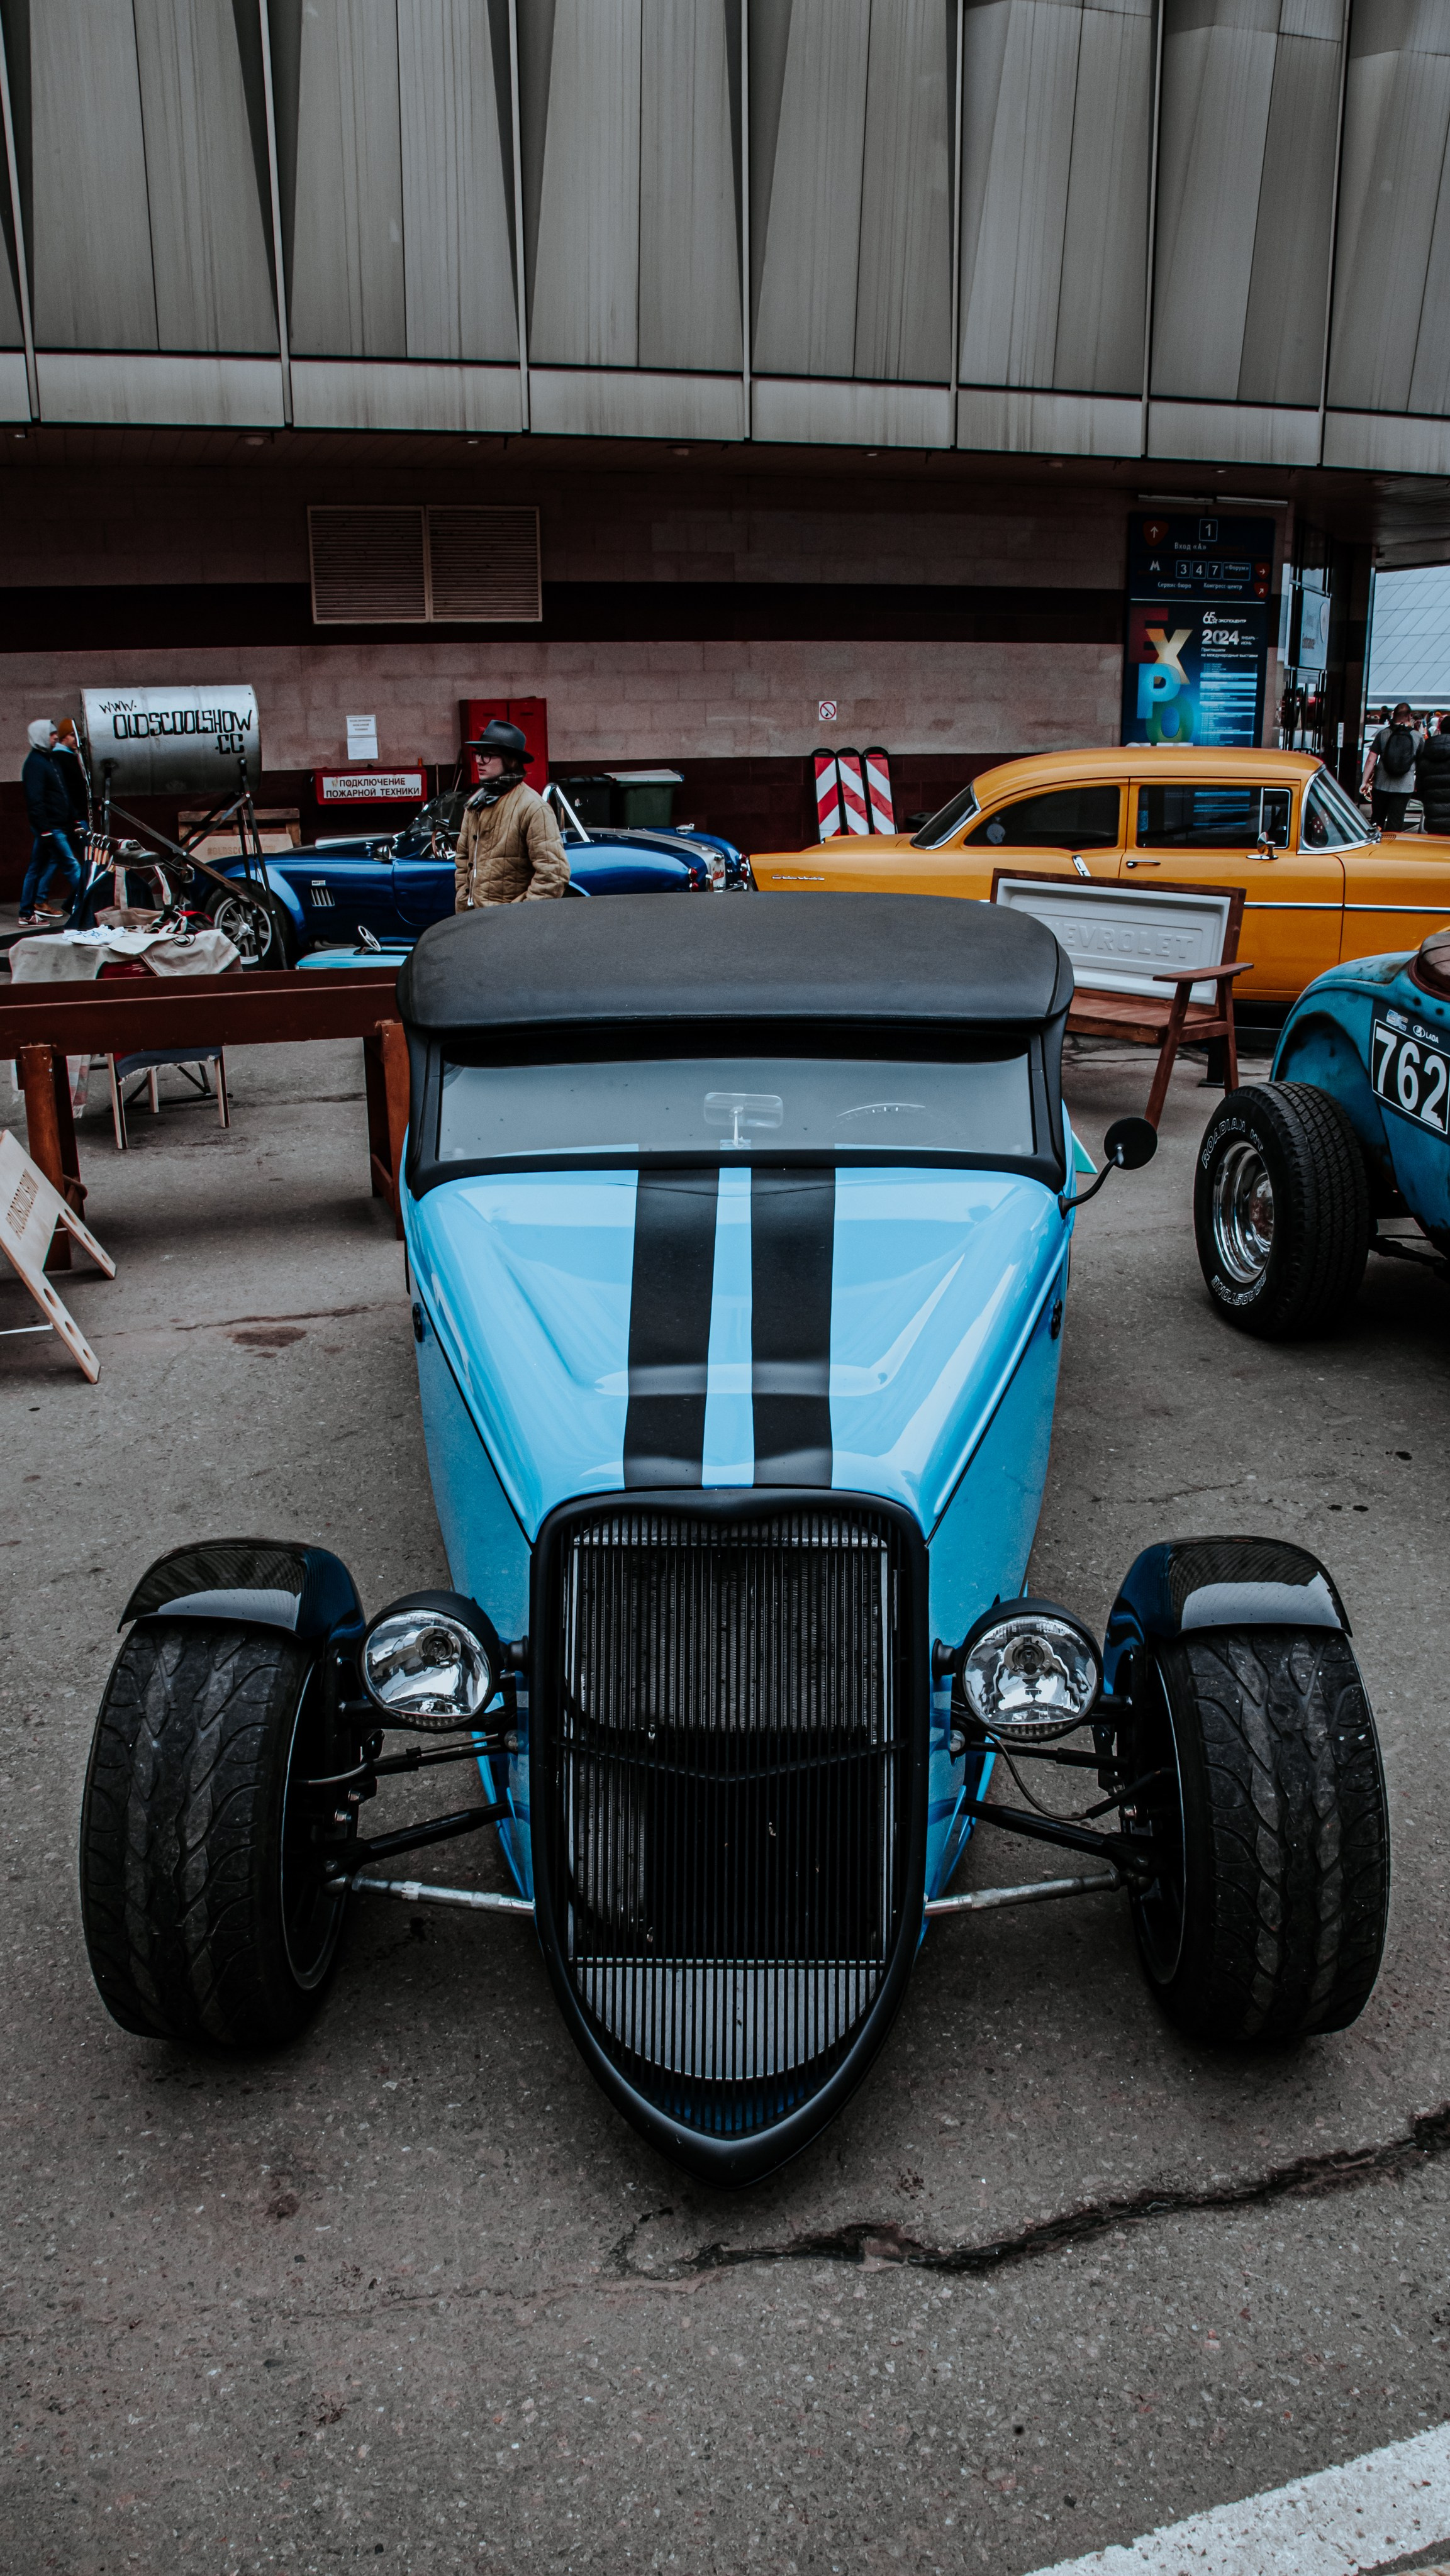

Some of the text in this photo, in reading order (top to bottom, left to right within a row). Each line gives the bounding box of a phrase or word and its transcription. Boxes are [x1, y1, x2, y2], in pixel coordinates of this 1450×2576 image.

[1205, 523, 1212, 536] 1
[1174, 542, 1191, 551] Вход
[1180, 564, 1187, 575] 3
[1196, 565, 1203, 575] 4
[1212, 565, 1219, 575] 7
[1202, 629, 1239, 645] 2024
[113, 709, 252, 740] OLDSCOOLSHOW
[339, 777, 406, 787] ПОДКЛЮЧЕНИЕ
[326, 787, 420, 797] ПОЖАРНОЙ ТЕХНИКИ
[1425, 1031, 1439, 1043] LADA
[1375, 1026, 1447, 1130] 762
[1202, 1118, 1246, 1169] ROADIAN
[1211, 1269, 1267, 1306] ROADSTONE
